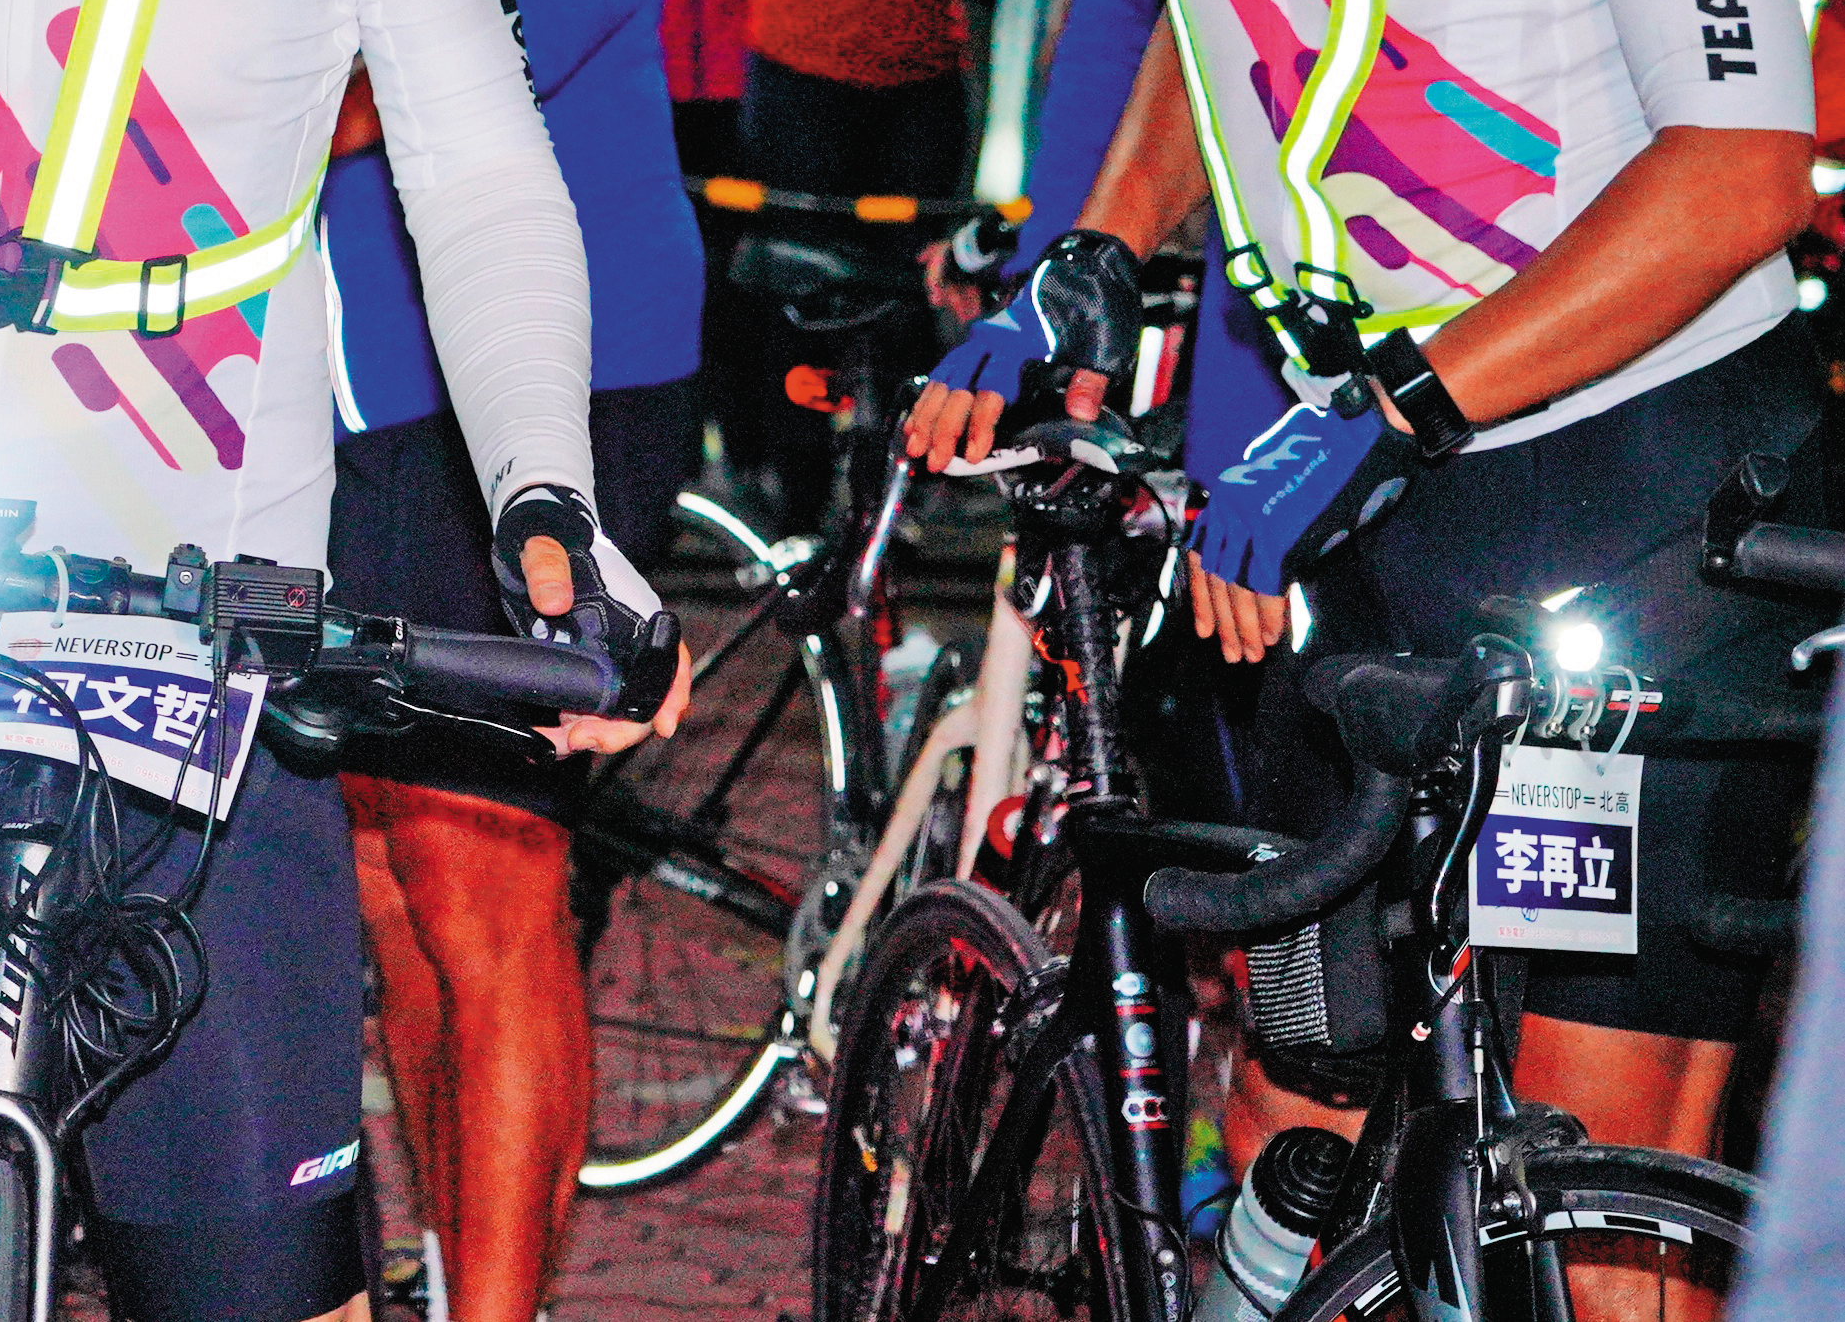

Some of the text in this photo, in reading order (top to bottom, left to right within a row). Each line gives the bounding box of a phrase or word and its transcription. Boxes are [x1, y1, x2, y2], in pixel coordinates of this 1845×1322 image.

[54, 636, 173, 662] NEVERSTOP
[1511, 782, 1630, 814] NEVERSTOP 北高
[1495, 828, 1618, 901] 李再立
[289, 1139, 361, 1187] GIAN
